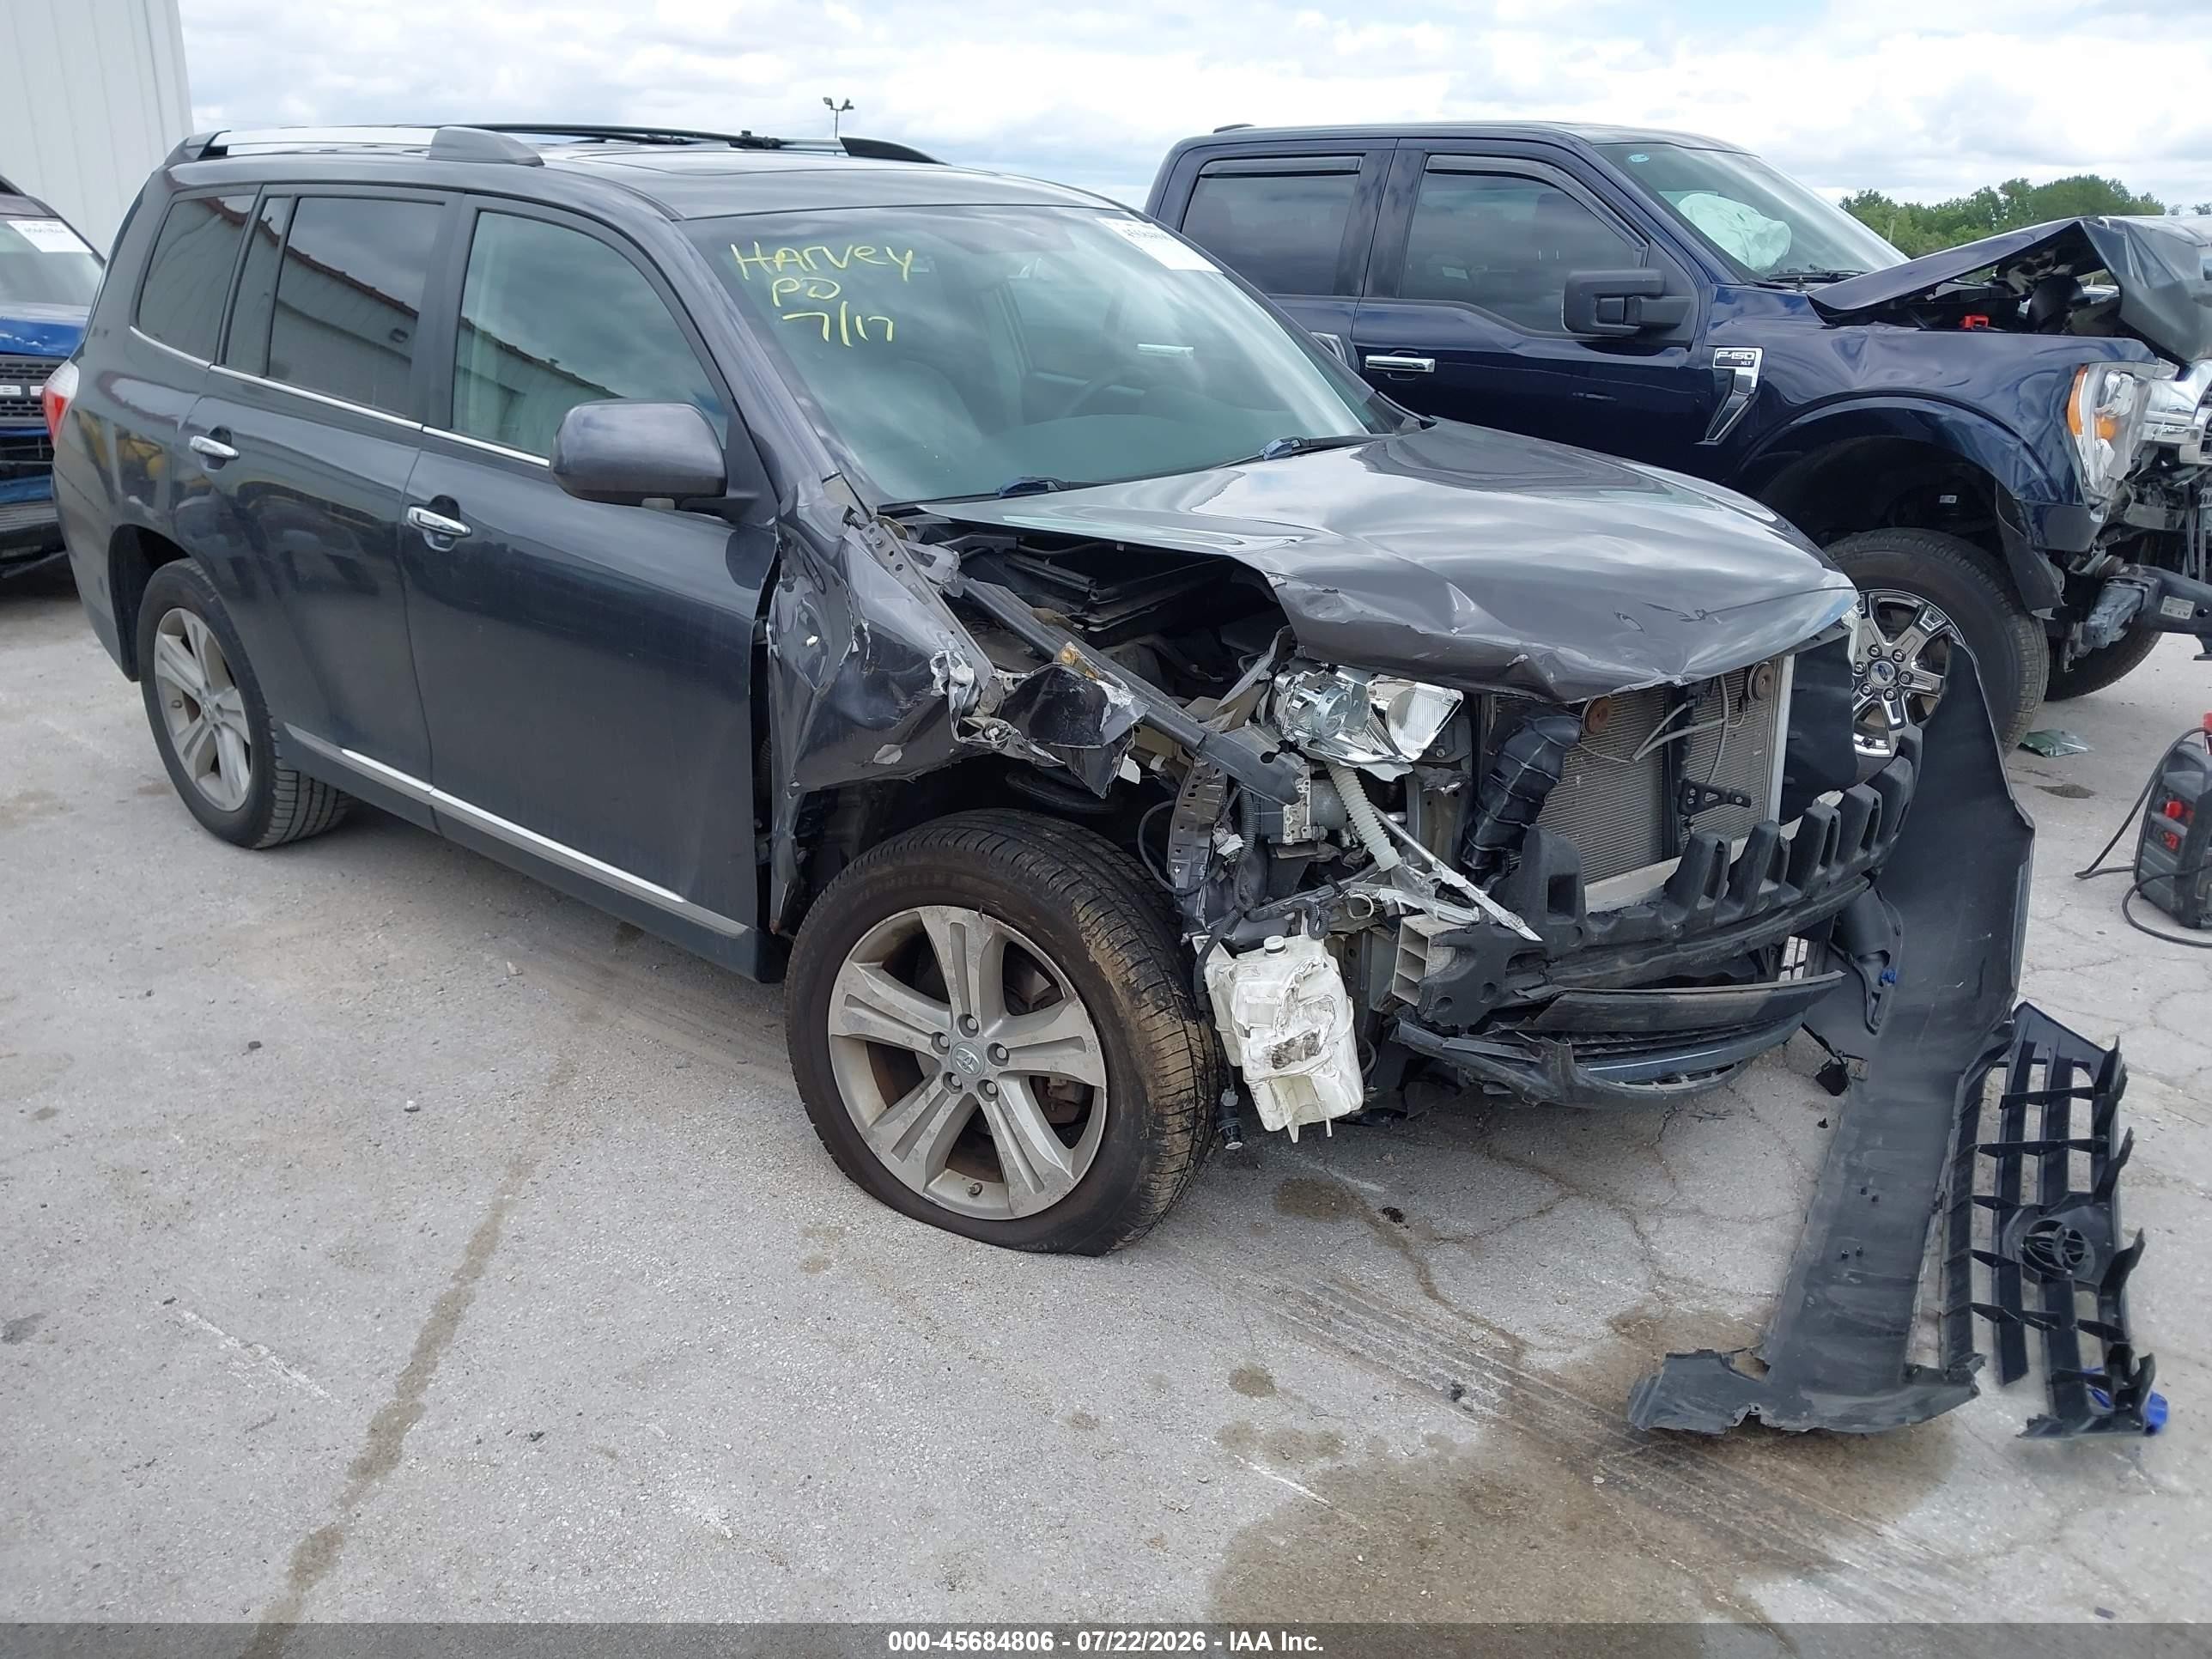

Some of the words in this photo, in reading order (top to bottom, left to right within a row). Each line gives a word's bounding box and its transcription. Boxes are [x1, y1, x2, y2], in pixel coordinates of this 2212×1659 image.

[773, 277, 842, 307] PD
[782, 301, 894, 347] 7/17
[1717, 351, 1756, 360] F-150
